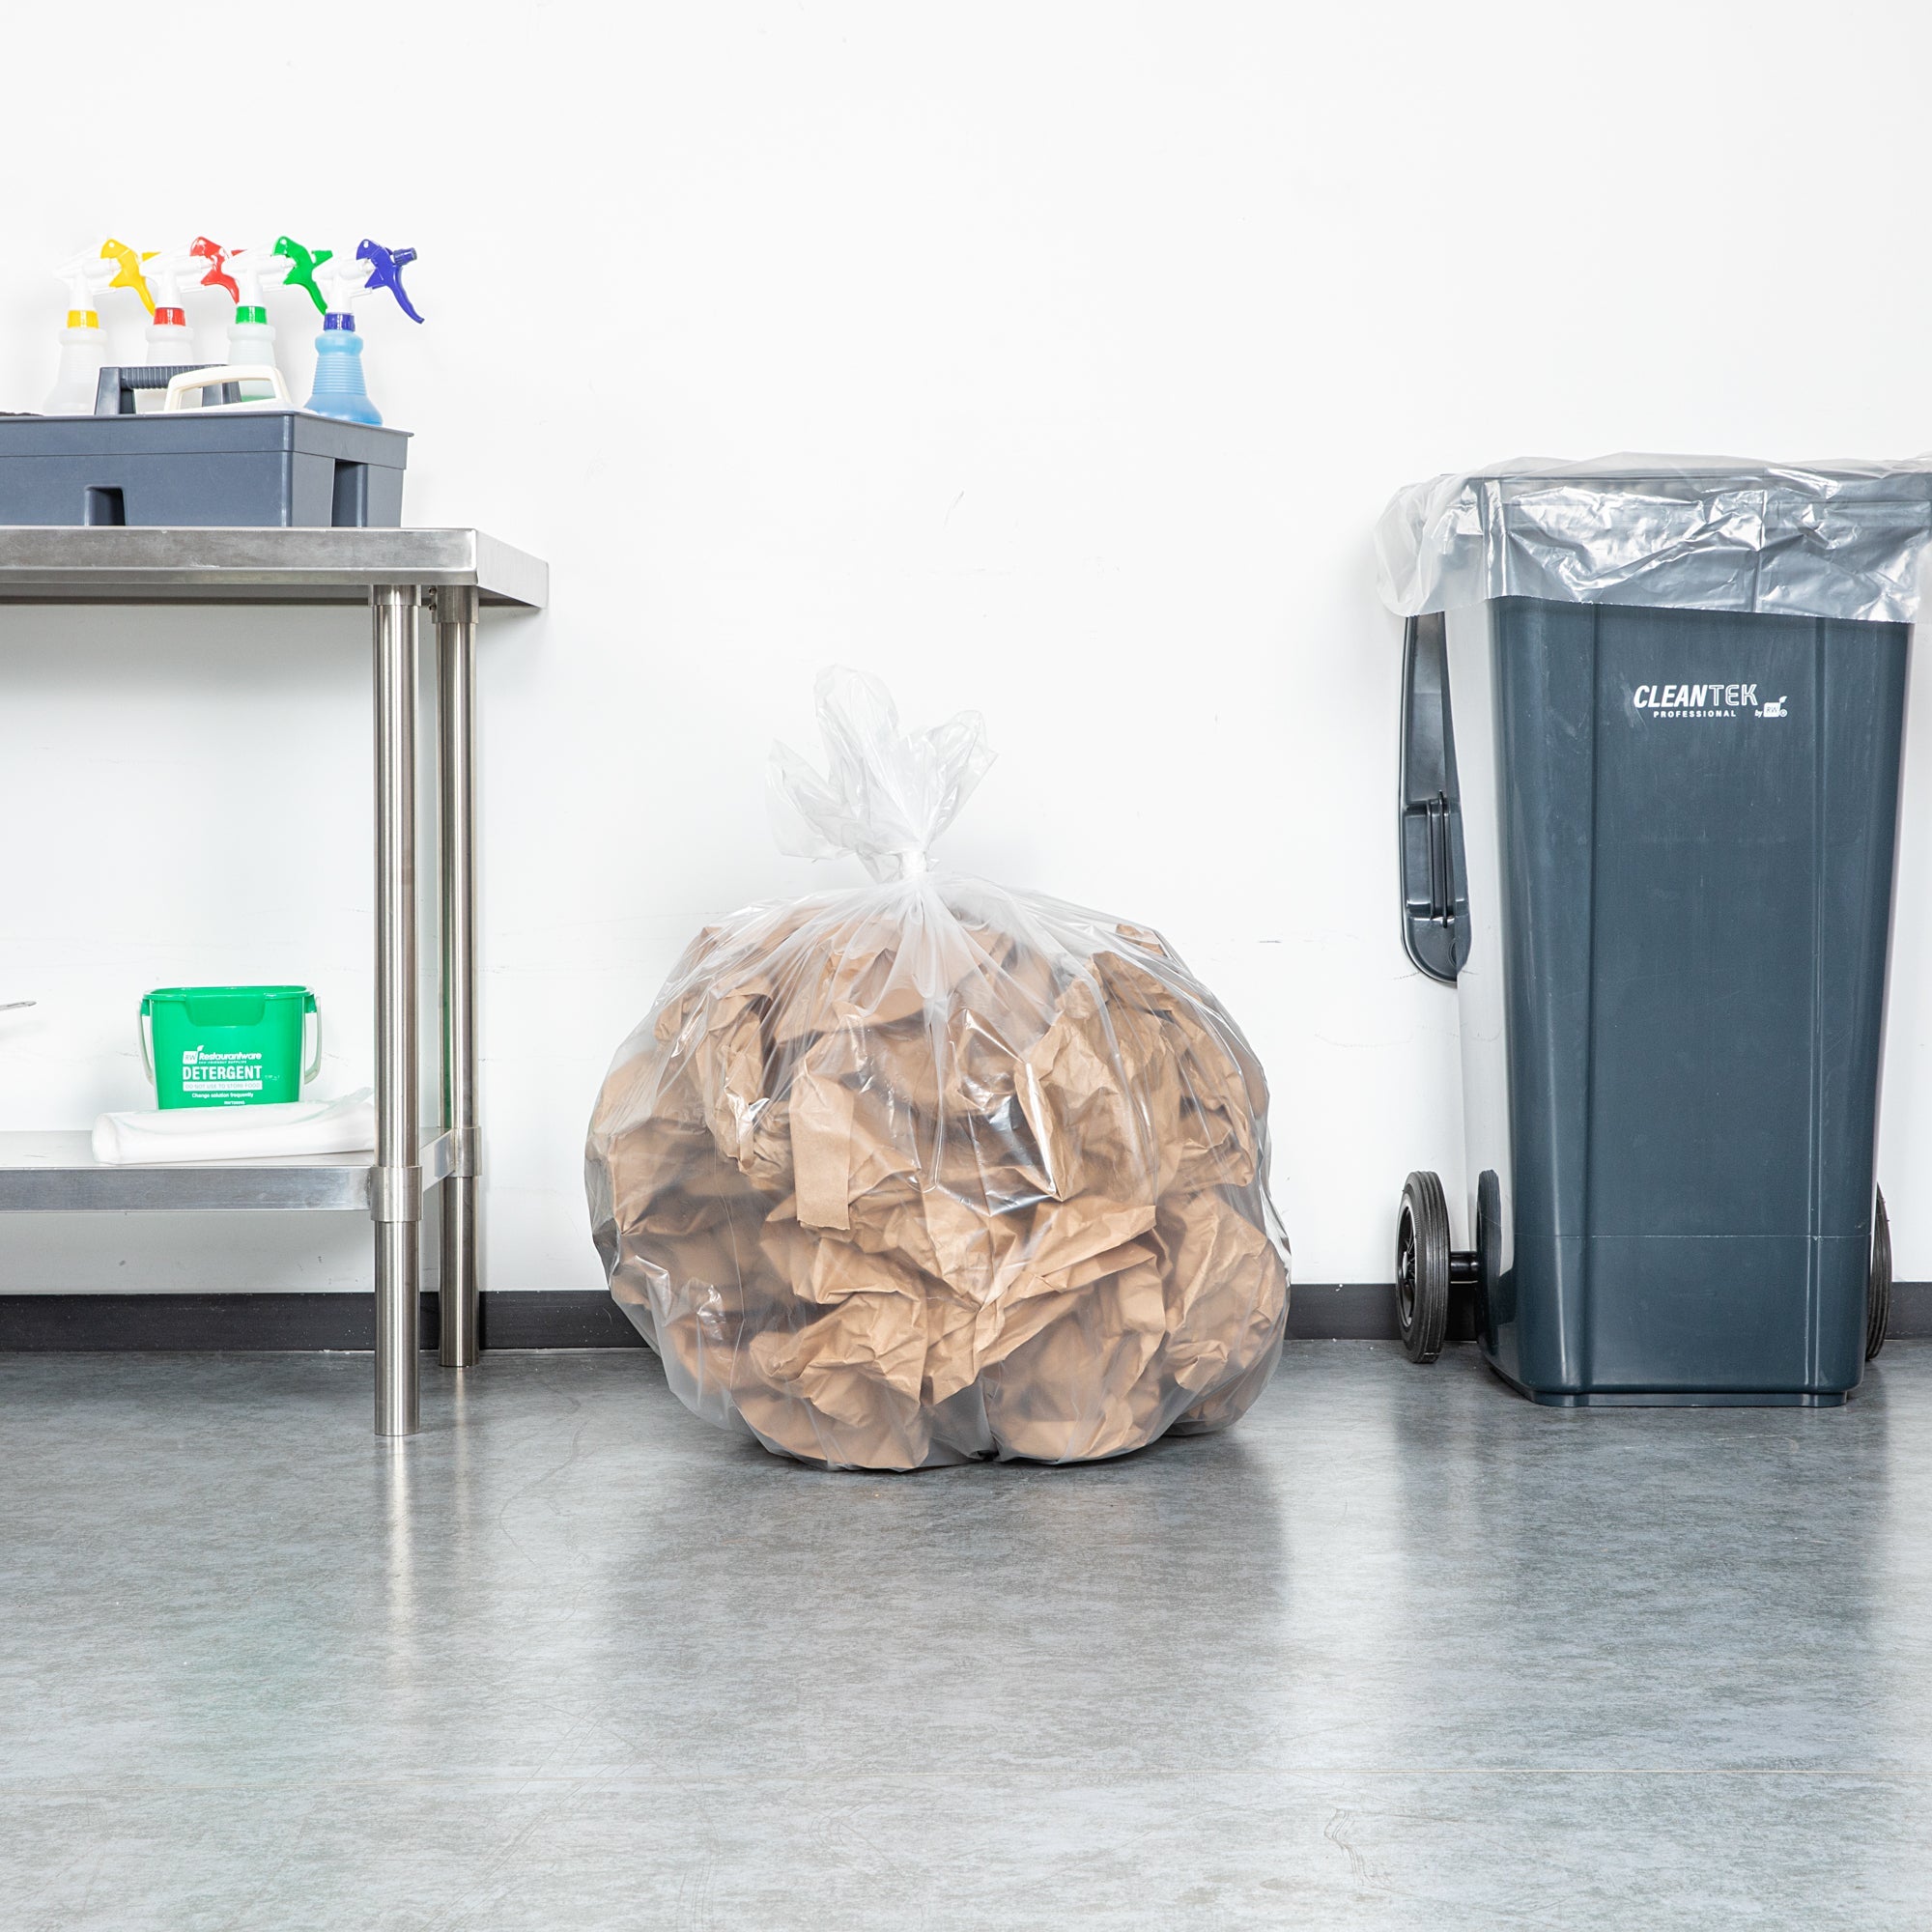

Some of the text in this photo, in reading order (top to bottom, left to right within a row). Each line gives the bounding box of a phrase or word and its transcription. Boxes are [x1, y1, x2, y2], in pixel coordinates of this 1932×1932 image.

[1634, 684, 1759, 708] CLEANTEK
[1754, 709, 1763, 719] by
[199, 1052, 263, 1061] Restaurantware
[183, 1065, 263, 1080] DETERGENT
